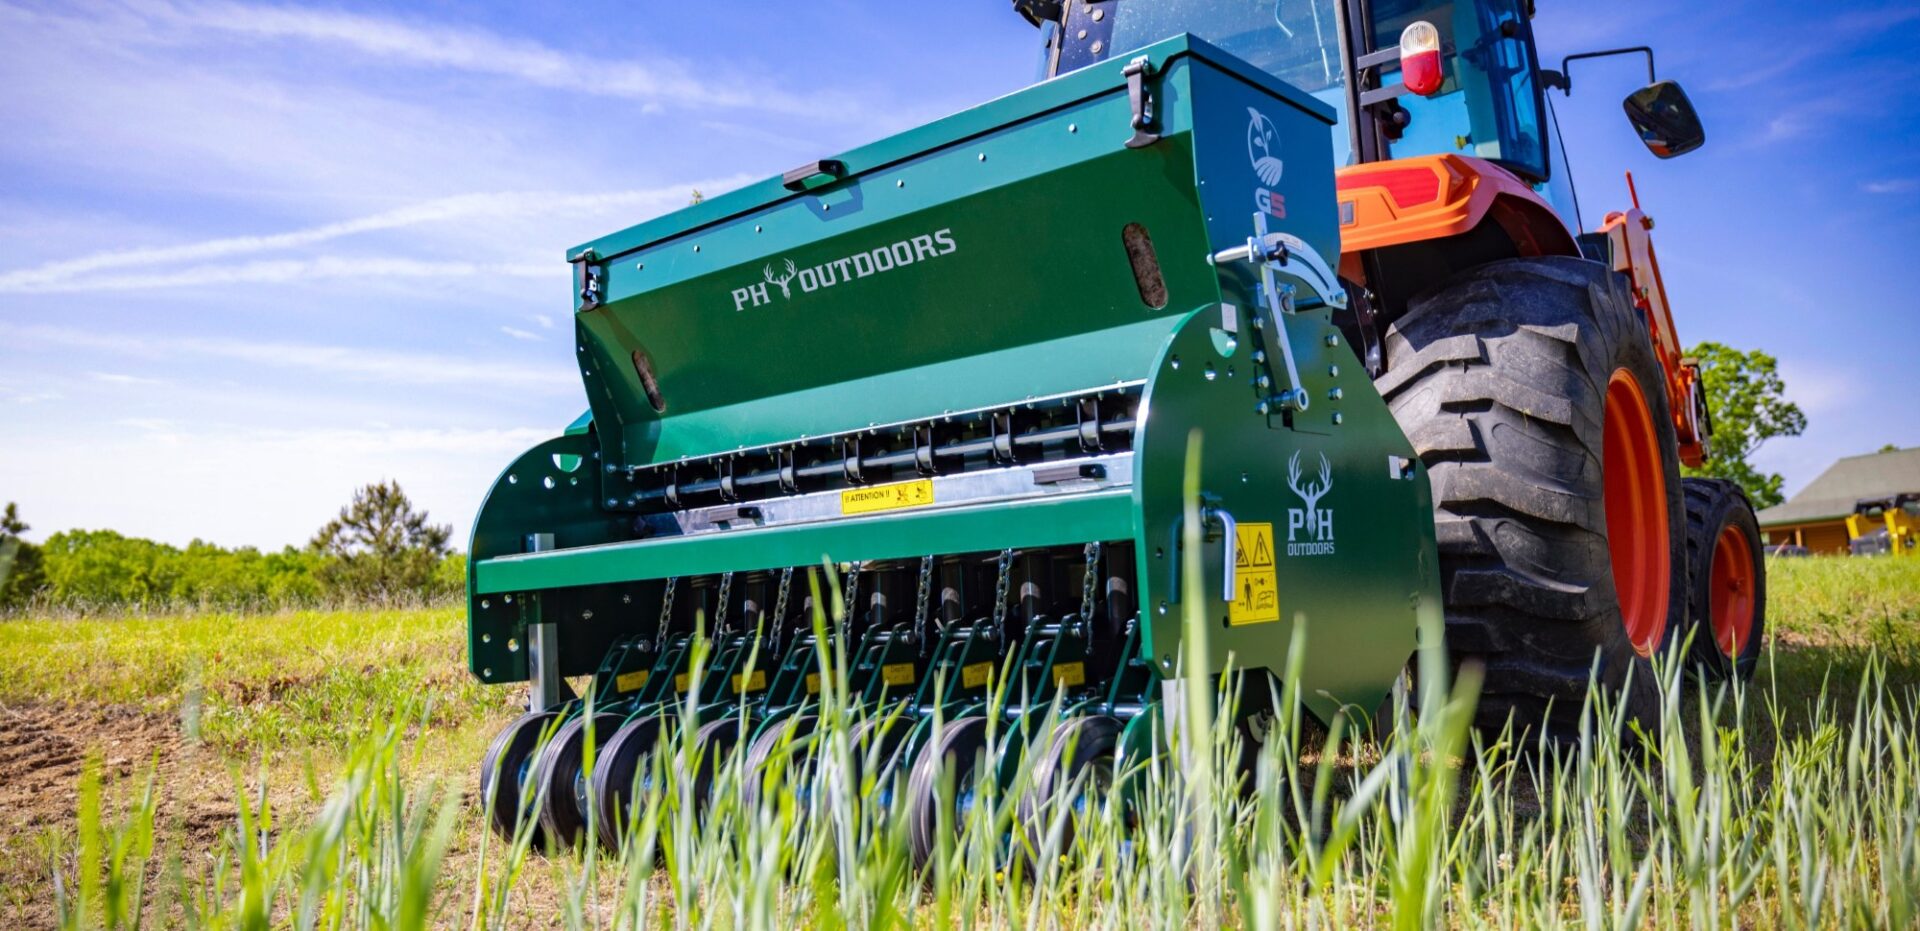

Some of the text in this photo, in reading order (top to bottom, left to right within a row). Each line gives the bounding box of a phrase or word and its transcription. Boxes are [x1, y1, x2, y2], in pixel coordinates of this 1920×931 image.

[731, 228, 957, 312] PH OUTDOORS
[850, 491, 884, 502] ATTENTION
[1287, 542, 1335, 556] OUTDOORS
